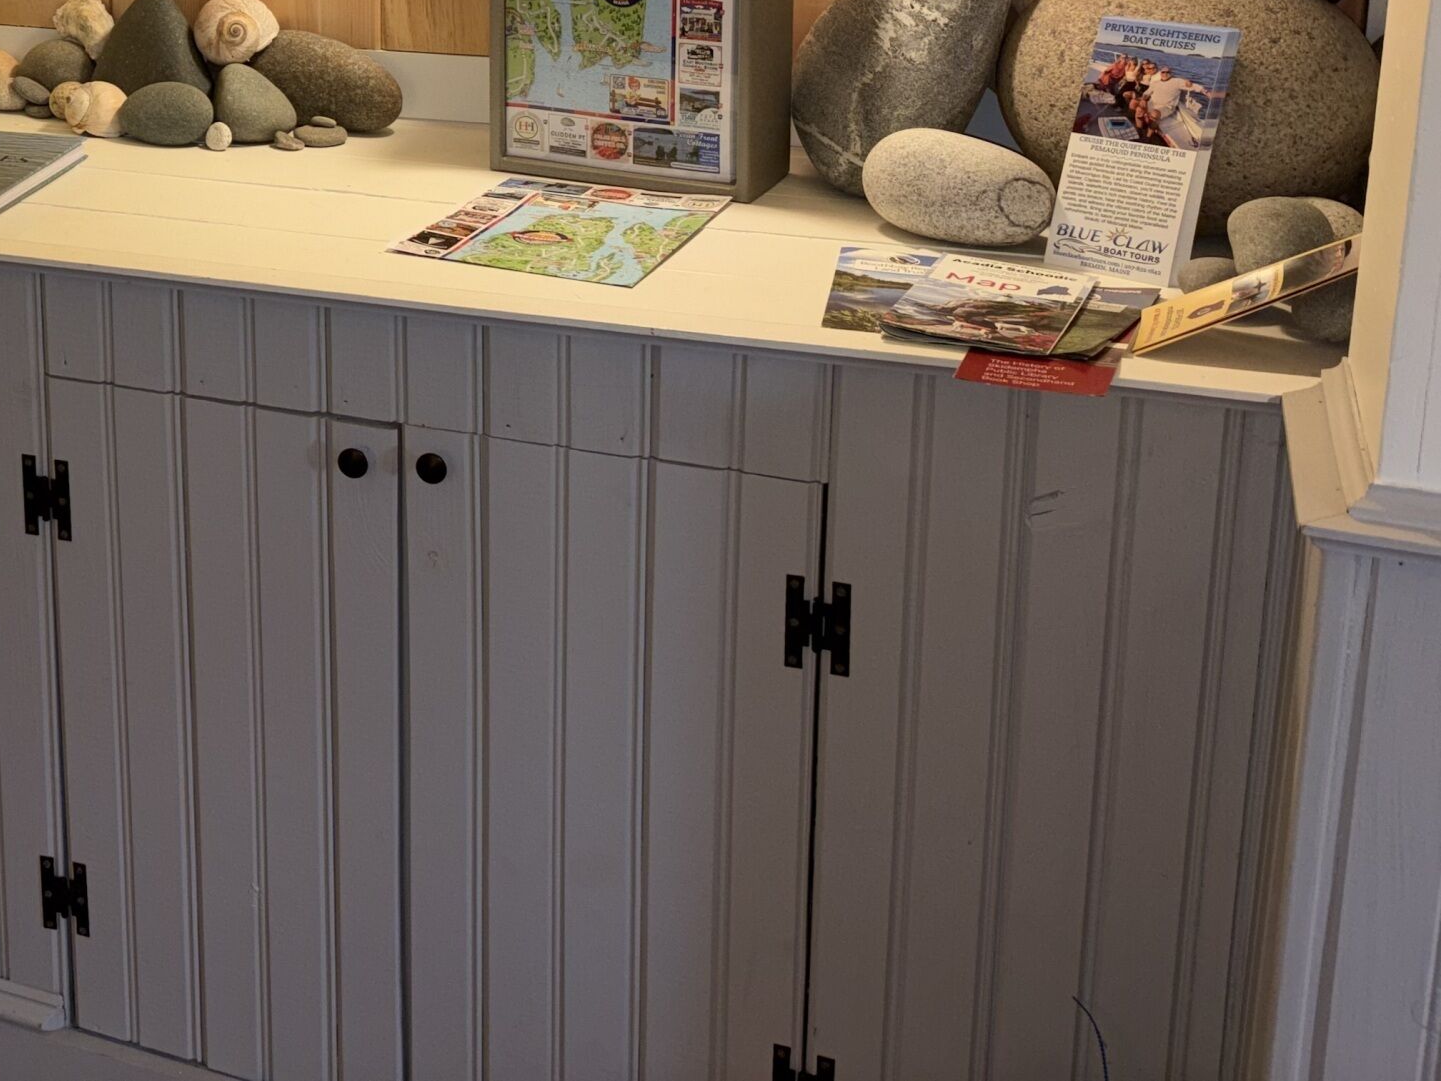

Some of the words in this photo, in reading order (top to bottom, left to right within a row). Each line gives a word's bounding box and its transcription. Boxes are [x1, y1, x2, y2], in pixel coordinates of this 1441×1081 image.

[1104, 22, 1147, 35] PRIVATE
[1149, 28, 1222, 44] SIGHTSEEING
[1122, 35, 1151, 45] BOAT
[1152, 38, 1197, 50] CRUISES
[551, 131, 577, 139] GLIDDEN
[1079, 135, 1104, 145] CRUISE
[1105, 139, 1120, 147] THE
[1120, 141, 1140, 150] QUIET
[1143, 145, 1159, 153] SIDE
[1160, 147, 1171, 155] OF
[1172, 149, 1187, 158] THE
[1090, 144, 1129, 156] PEMAQUID
[1130, 150, 1171, 162] PENINSULA
[1056, 223, 1103, 242] BLUE
[1113, 234, 1169, 254] CLAW
[1104, 247, 1128, 257] BOAT
[1130, 251, 1160, 264] TOURS
[952, 258, 1003, 271] Acadia
[1007, 266, 1078, 282] Schoodic
[945, 271, 1022, 291] Map
[986, 367, 1018, 376] Public
[1021, 371, 1059, 380] Library
[1012, 361, 1049, 370] History
[981, 375, 1008, 384] Book
[1012, 379, 1040, 388] Shop
[1007, 373, 1075, 386] Secondhand
